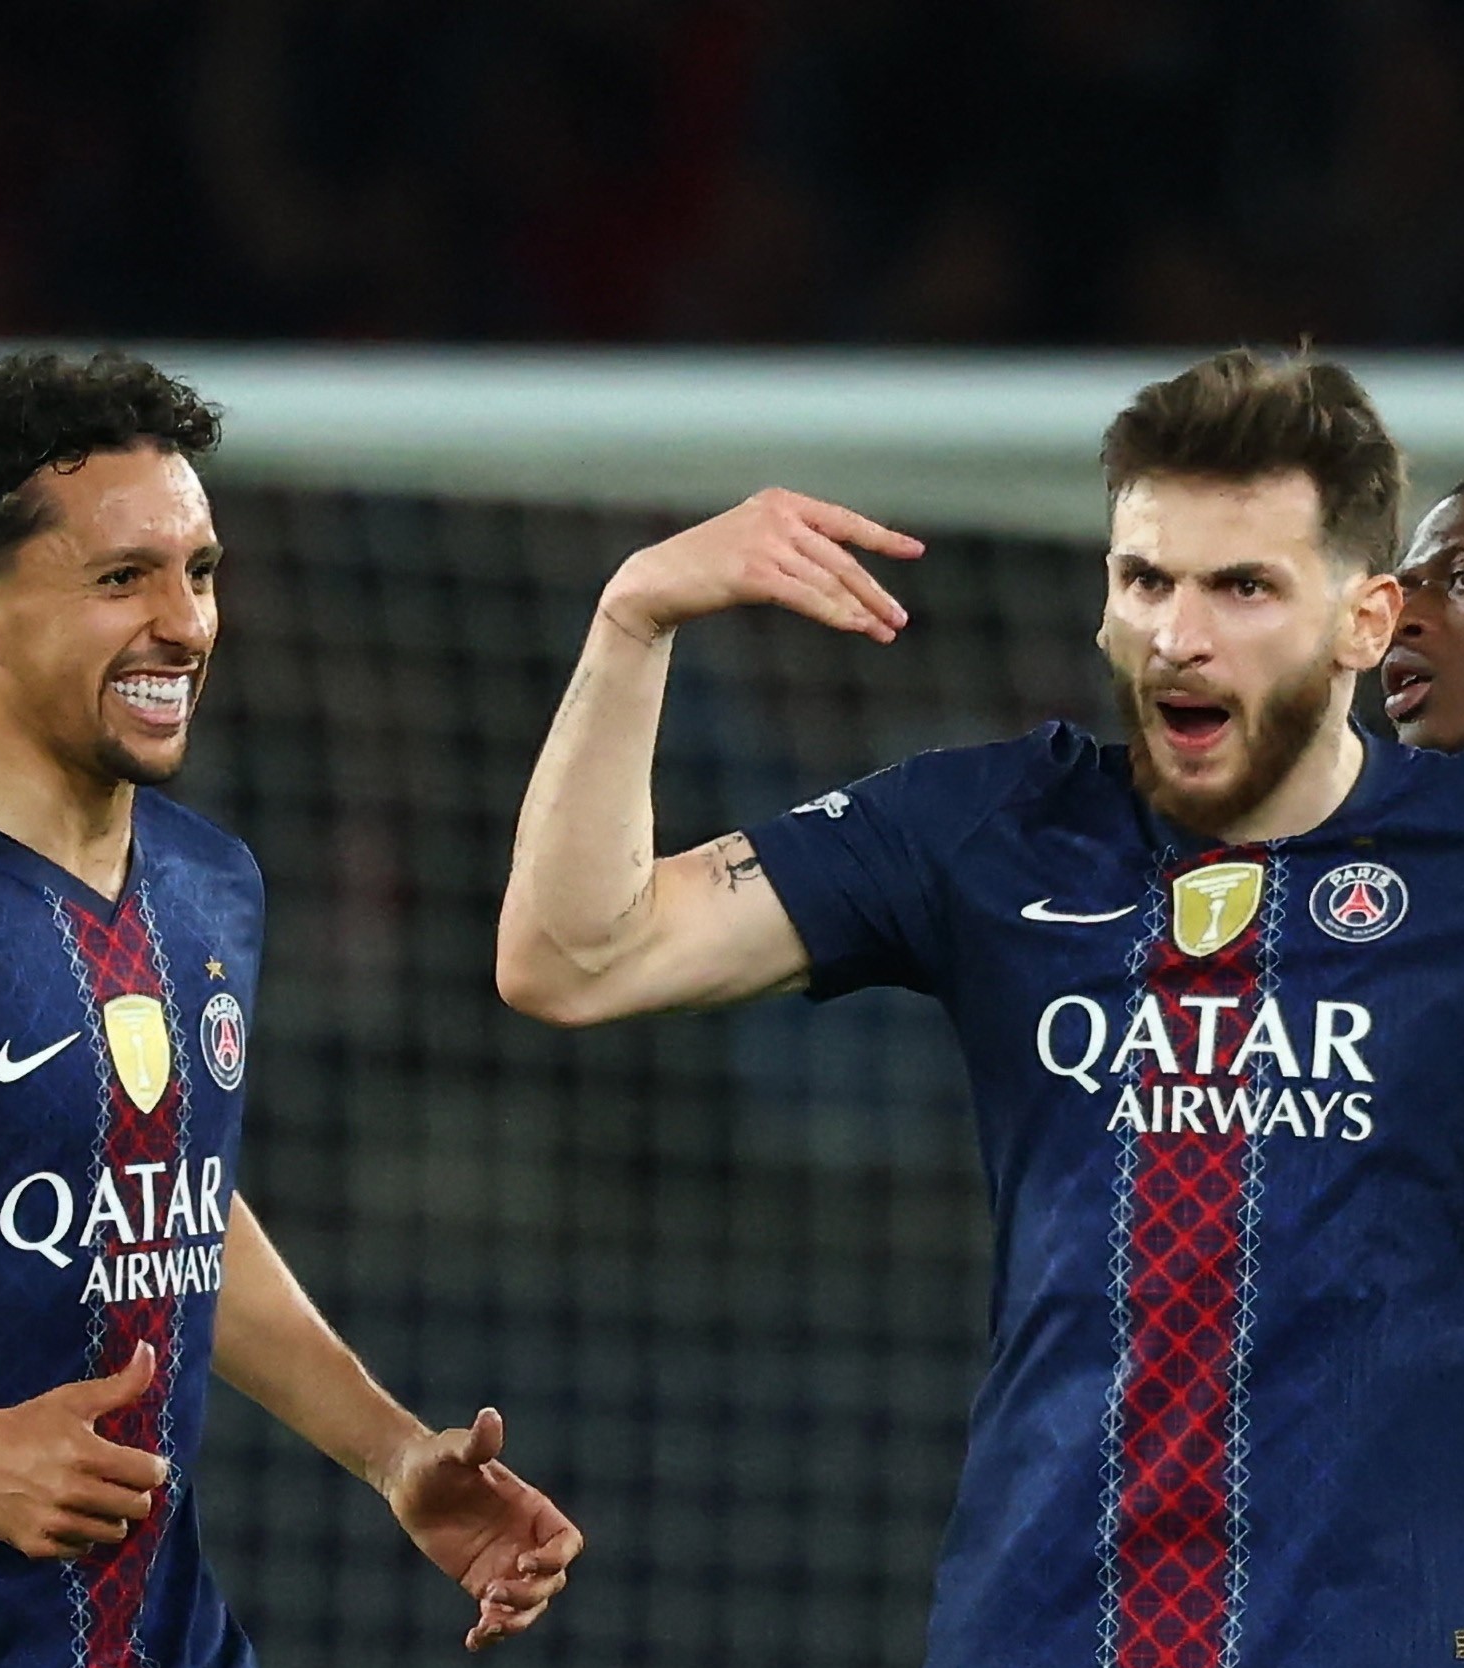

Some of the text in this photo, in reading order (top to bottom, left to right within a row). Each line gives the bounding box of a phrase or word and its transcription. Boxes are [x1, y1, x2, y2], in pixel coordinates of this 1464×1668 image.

[1330, 867, 1391, 887] PARIS
[1037, 994, 1375, 1094] QATAR
[1106, 1086, 1374, 1141] AIRWAYS
[0, 1156, 226, 1268] QATAR
[79, 1243, 224, 1304] AIRWAYS
